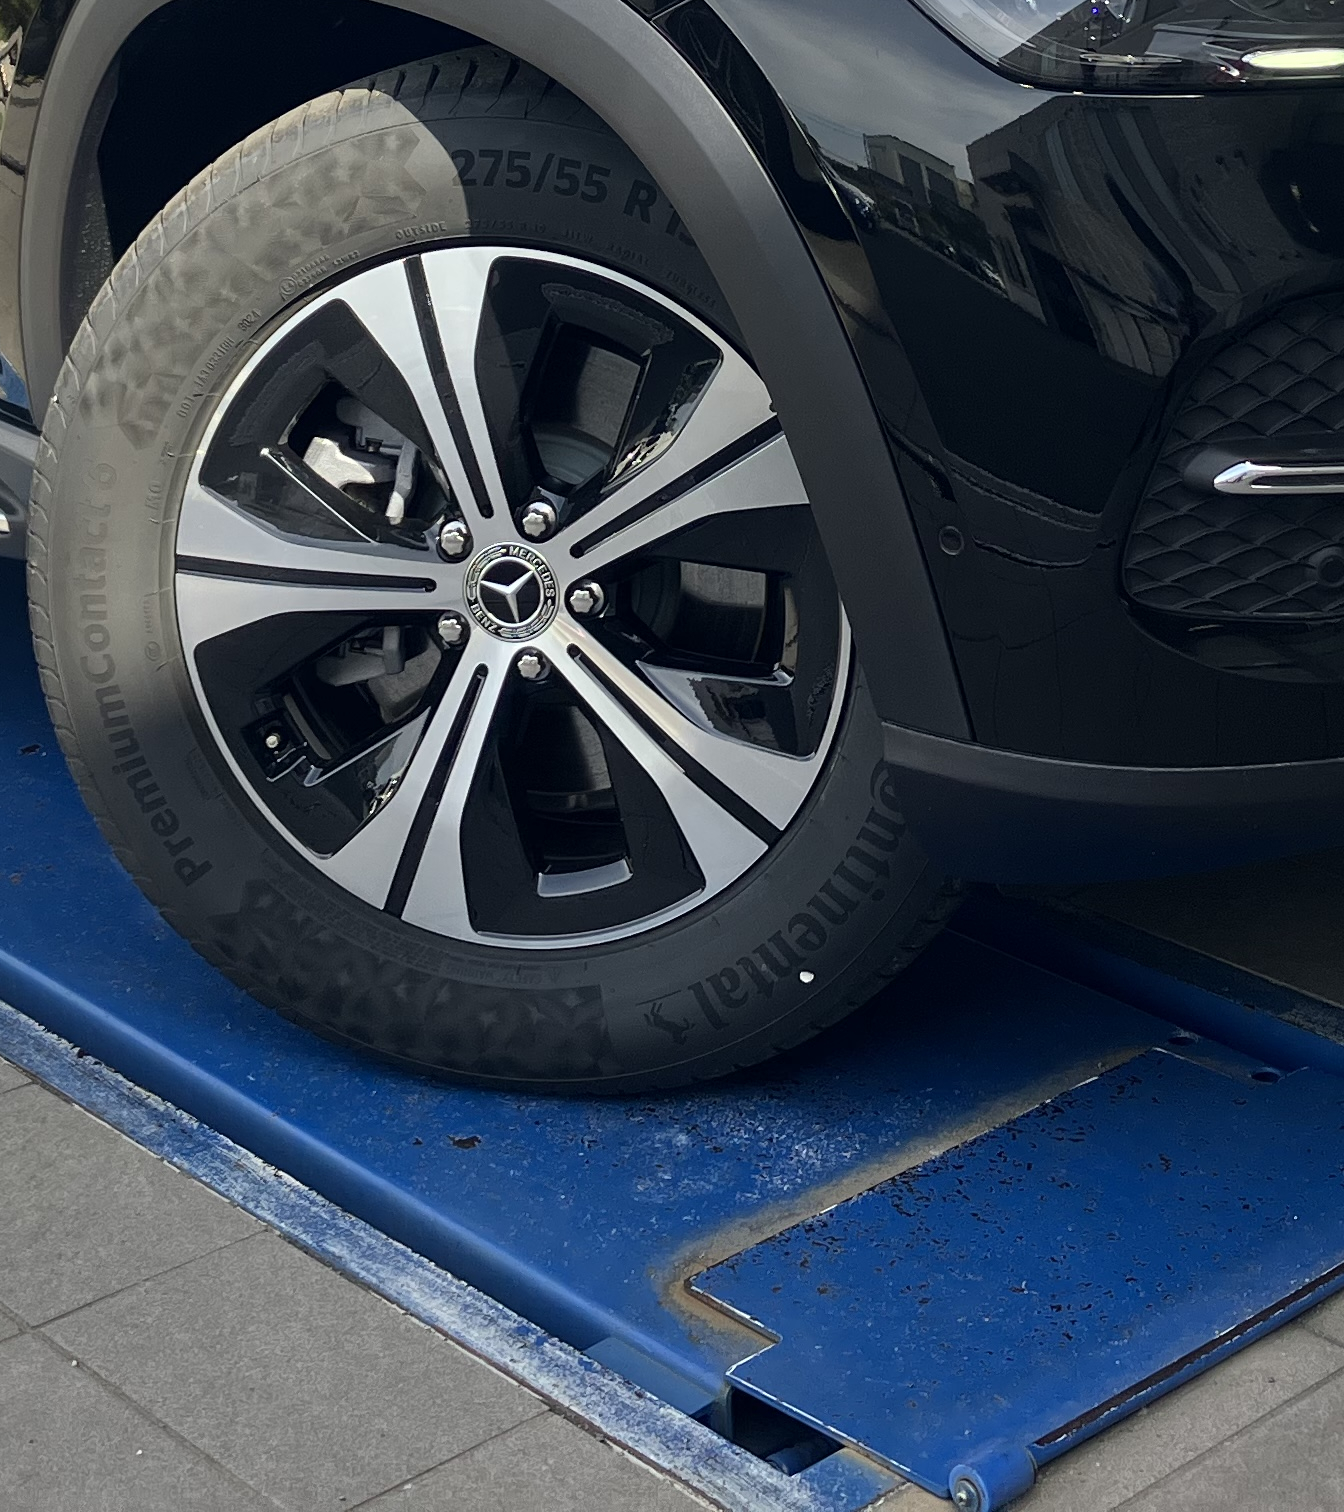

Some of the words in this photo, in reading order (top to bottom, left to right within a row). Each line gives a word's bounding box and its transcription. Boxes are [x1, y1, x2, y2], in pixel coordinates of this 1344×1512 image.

[451, 148, 612, 204] 275/55
[623, 179, 658, 225] R
[394, 221, 448, 241] OUTSIDE
[82, 462, 118, 488] 6
[508, 545, 556, 598] MERCEDES
[470, 603, 498, 634] BENZ
[73, 500, 213, 888] PremiumContact
